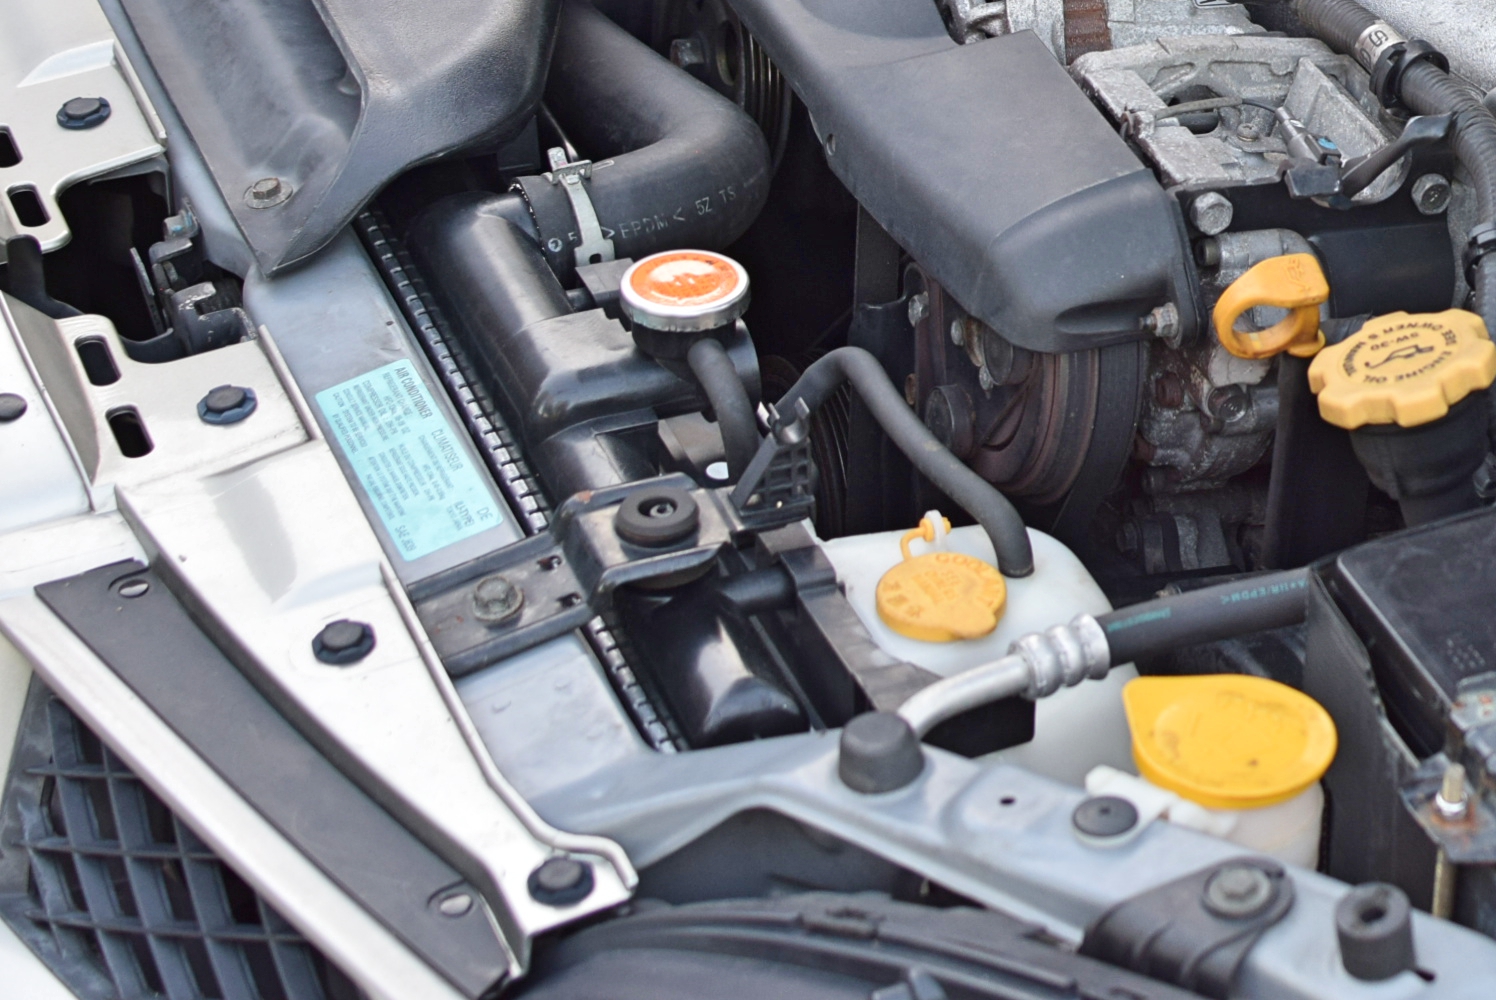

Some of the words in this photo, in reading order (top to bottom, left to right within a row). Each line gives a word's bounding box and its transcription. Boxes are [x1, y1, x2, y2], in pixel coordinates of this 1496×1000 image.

[393, 365, 410, 379] AIR
[1361, 373, 1387, 384] OIL
[1393, 349, 1451, 382] ENGINE
[399, 375, 434, 420] CONDITIONER
[429, 427, 464, 472] CLIMATISEUR
